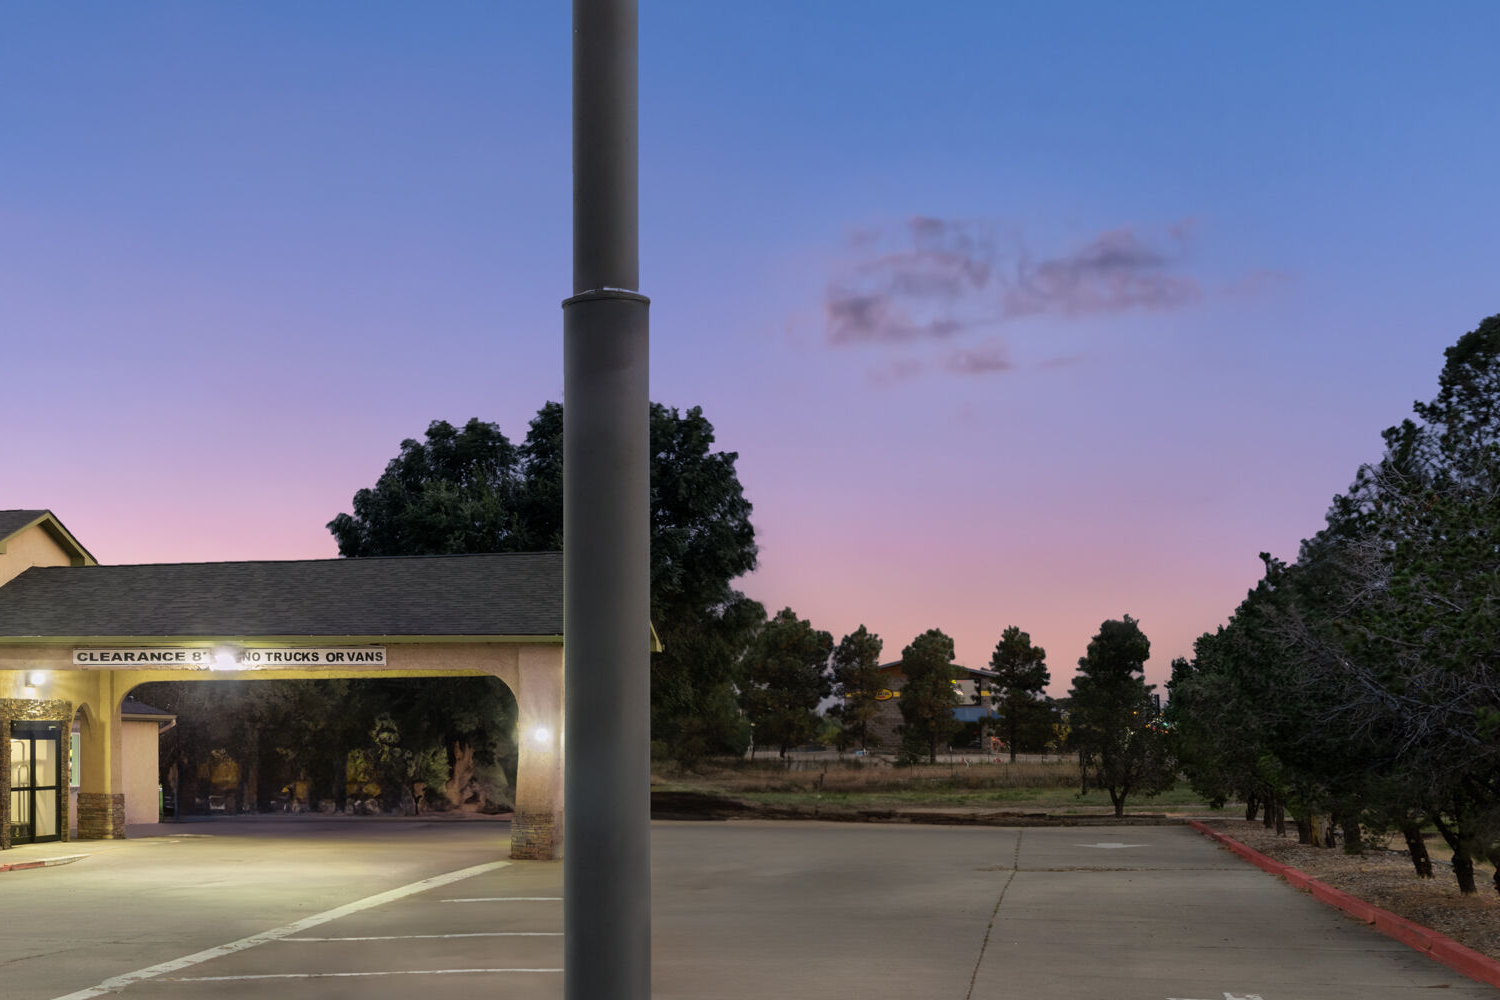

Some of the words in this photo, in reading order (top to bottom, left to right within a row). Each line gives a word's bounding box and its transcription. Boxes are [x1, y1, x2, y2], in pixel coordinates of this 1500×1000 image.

[76, 652, 186, 662] CLEARANCE
[243, 652, 261, 662] NO
[265, 652, 320, 662] TRUCKS
